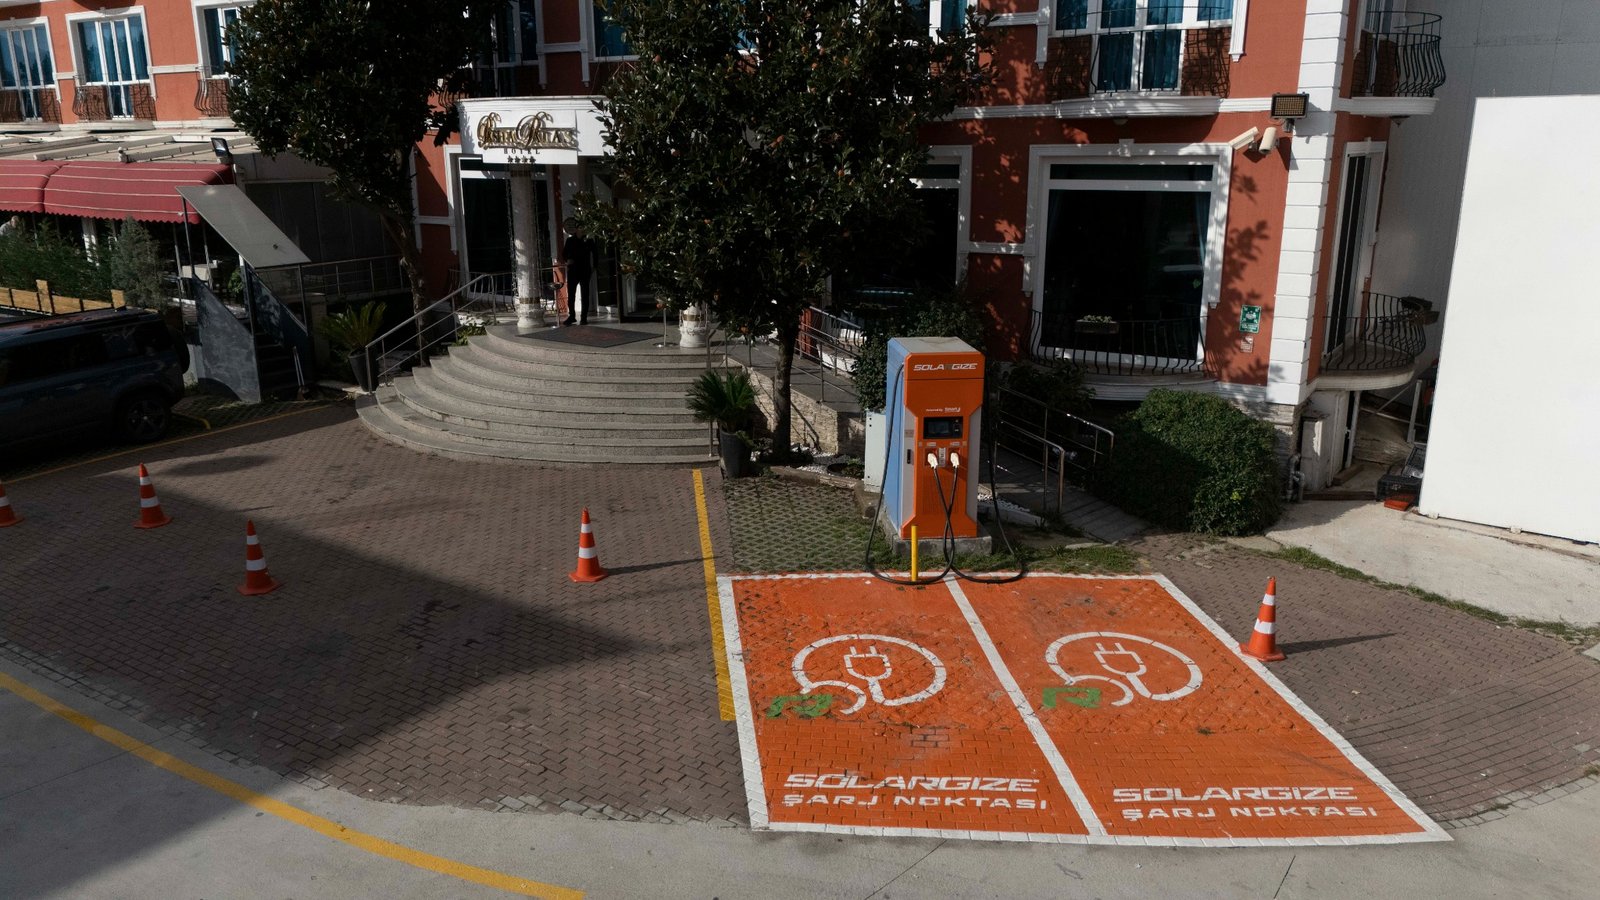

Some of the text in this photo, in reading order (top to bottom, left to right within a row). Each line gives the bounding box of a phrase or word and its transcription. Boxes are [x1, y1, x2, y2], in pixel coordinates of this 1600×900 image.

[784, 774, 1040, 793] SOLARGIZE
[781, 794, 1047, 809] ŞARJ NOKTASI
[1112, 786, 1357, 803] SOLARGIZE
[1122, 807, 1378, 821] ŞARJ NOKTASI
